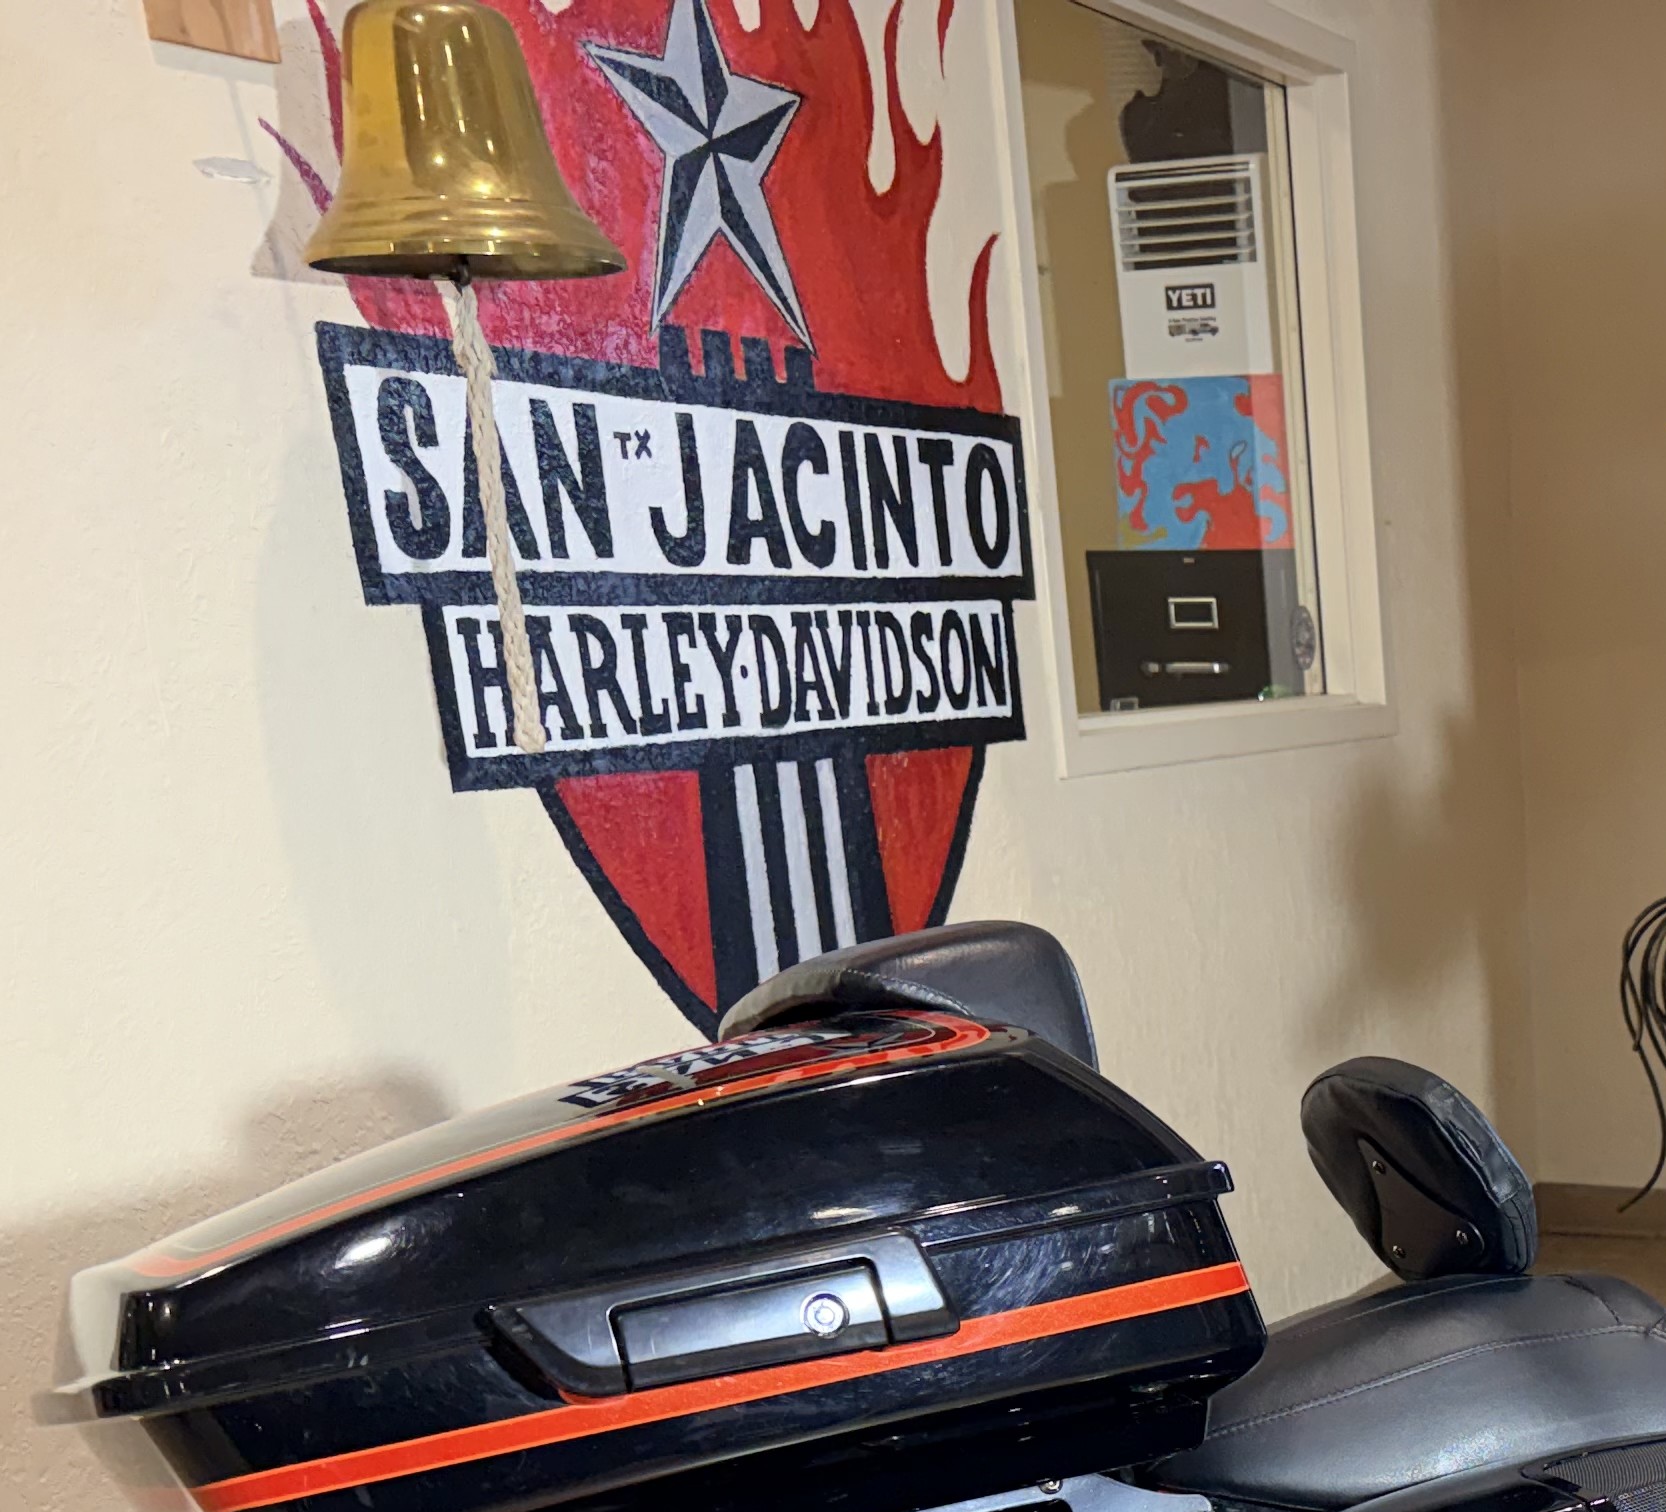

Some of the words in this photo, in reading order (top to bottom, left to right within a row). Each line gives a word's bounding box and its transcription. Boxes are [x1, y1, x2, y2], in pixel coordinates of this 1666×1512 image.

[1167, 287, 1212, 308] YETI
[376, 374, 613, 563] SAN
[613, 429, 652, 460] TX
[649, 411, 1012, 571] JACINTO
